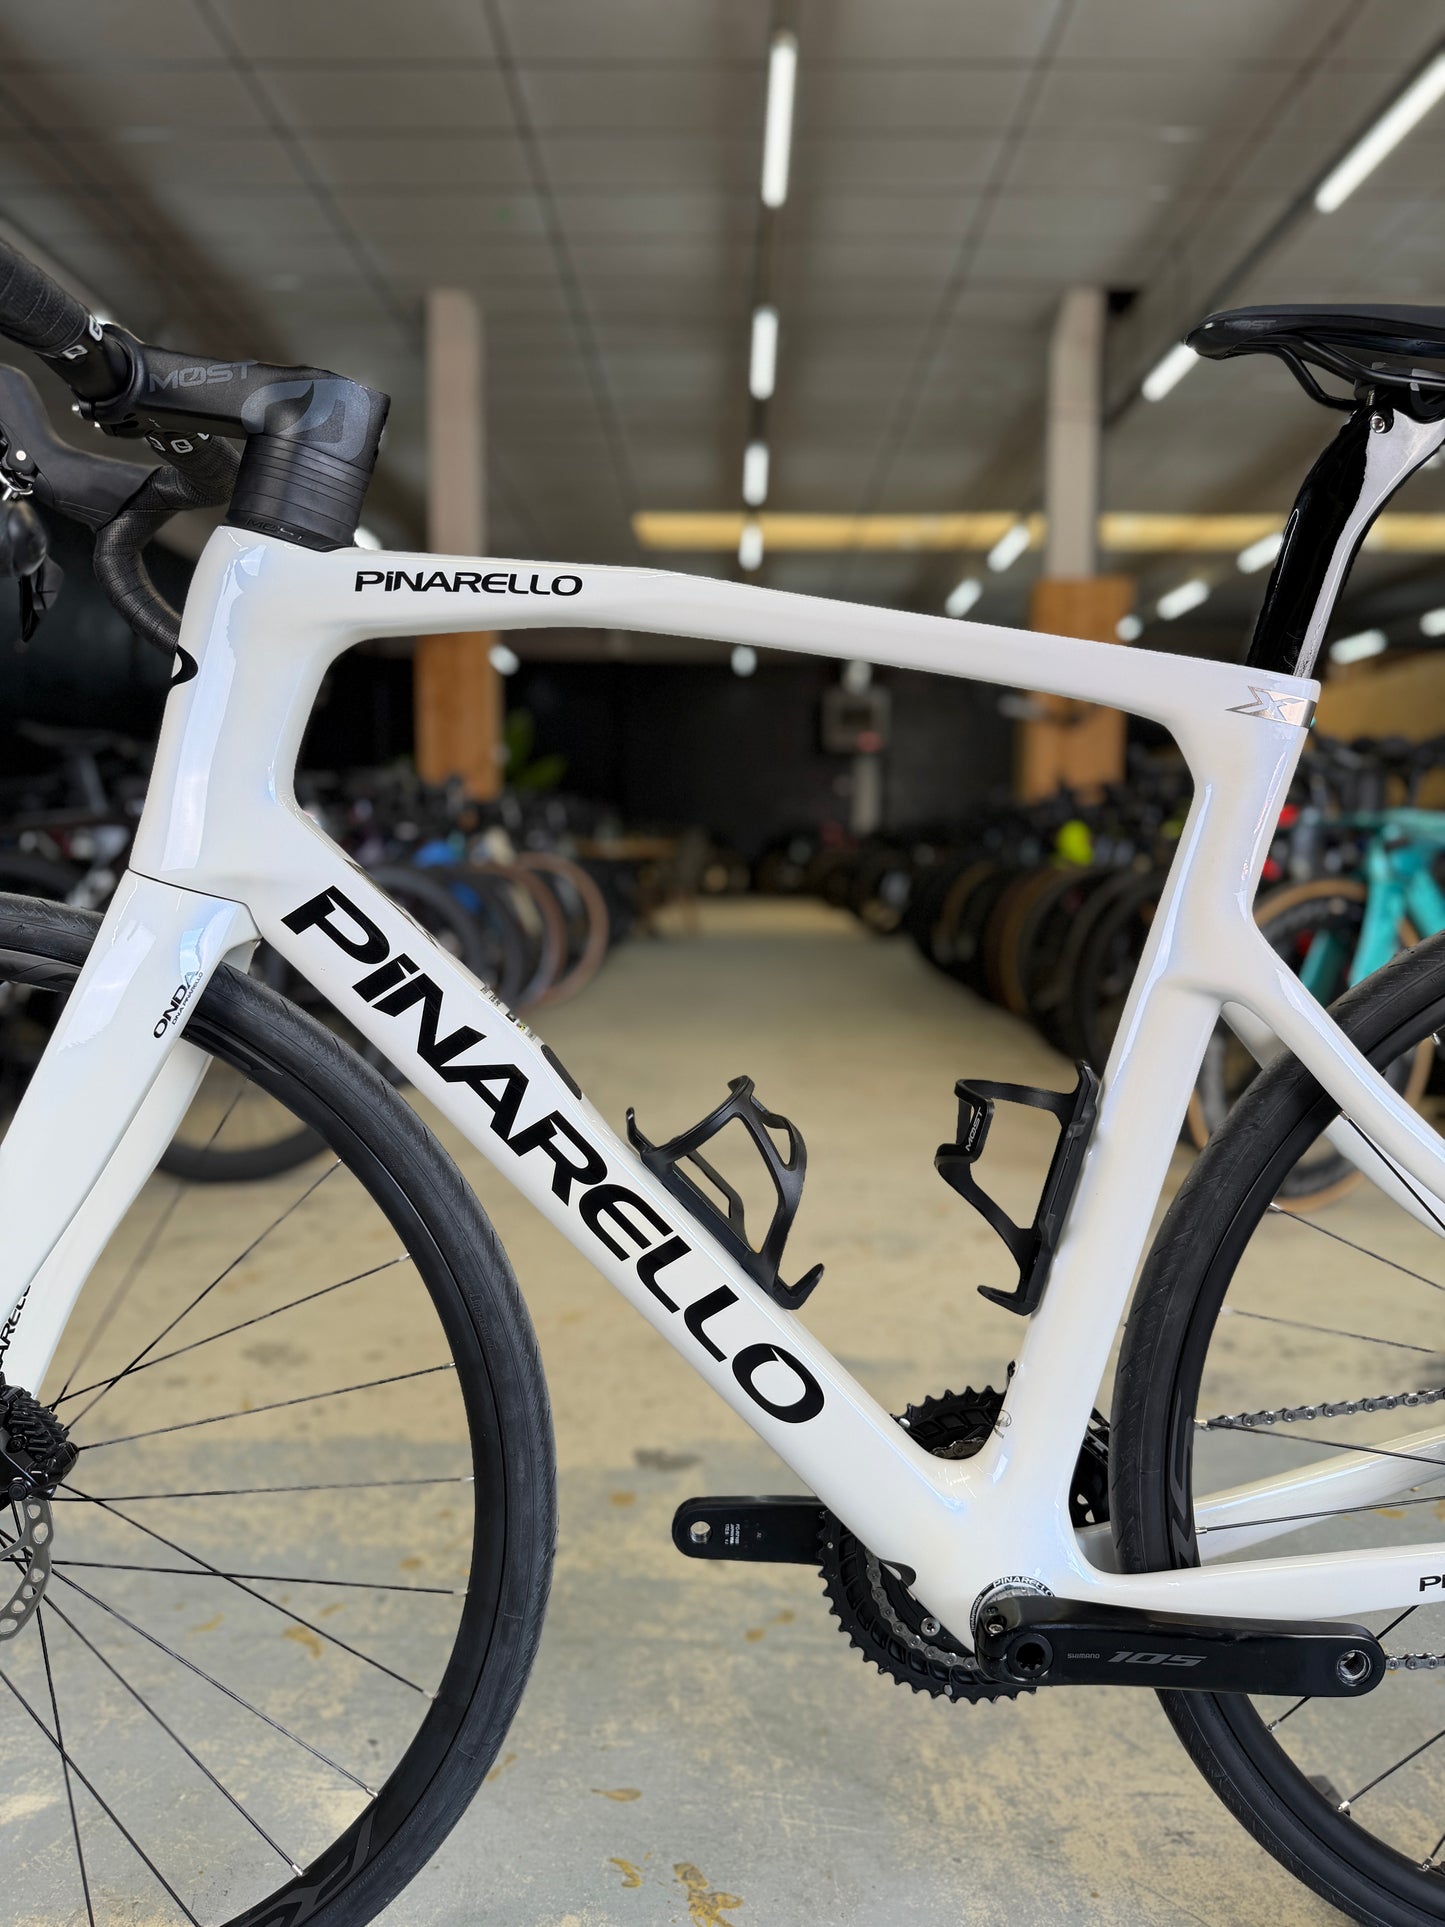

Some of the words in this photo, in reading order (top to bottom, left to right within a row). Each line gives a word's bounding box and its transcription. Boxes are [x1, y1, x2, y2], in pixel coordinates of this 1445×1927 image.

[153, 970, 198, 1038] ONDA
[1067, 1652, 1100, 1660] SHIMANO
[1107, 1651, 1208, 1667] 105
